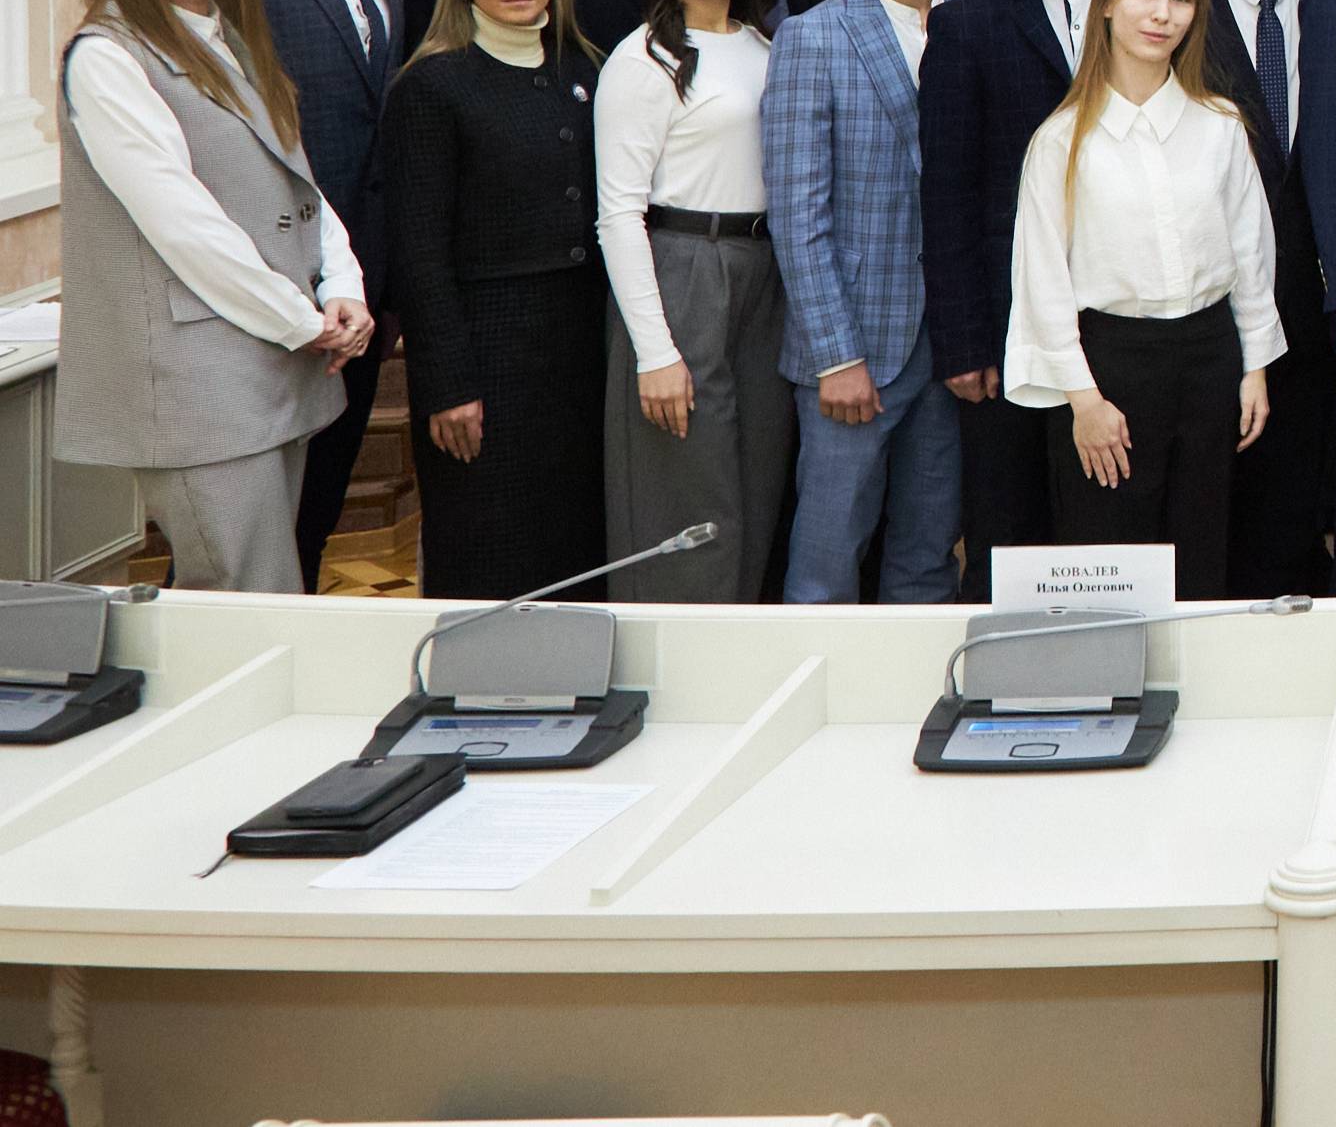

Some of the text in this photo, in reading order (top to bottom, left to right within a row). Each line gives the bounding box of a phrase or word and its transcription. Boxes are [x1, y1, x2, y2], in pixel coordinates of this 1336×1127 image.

[1050, 565, 1120, 578] КОВАЛЕВ
[1036, 581, 1134, 594] Илья Олегович
